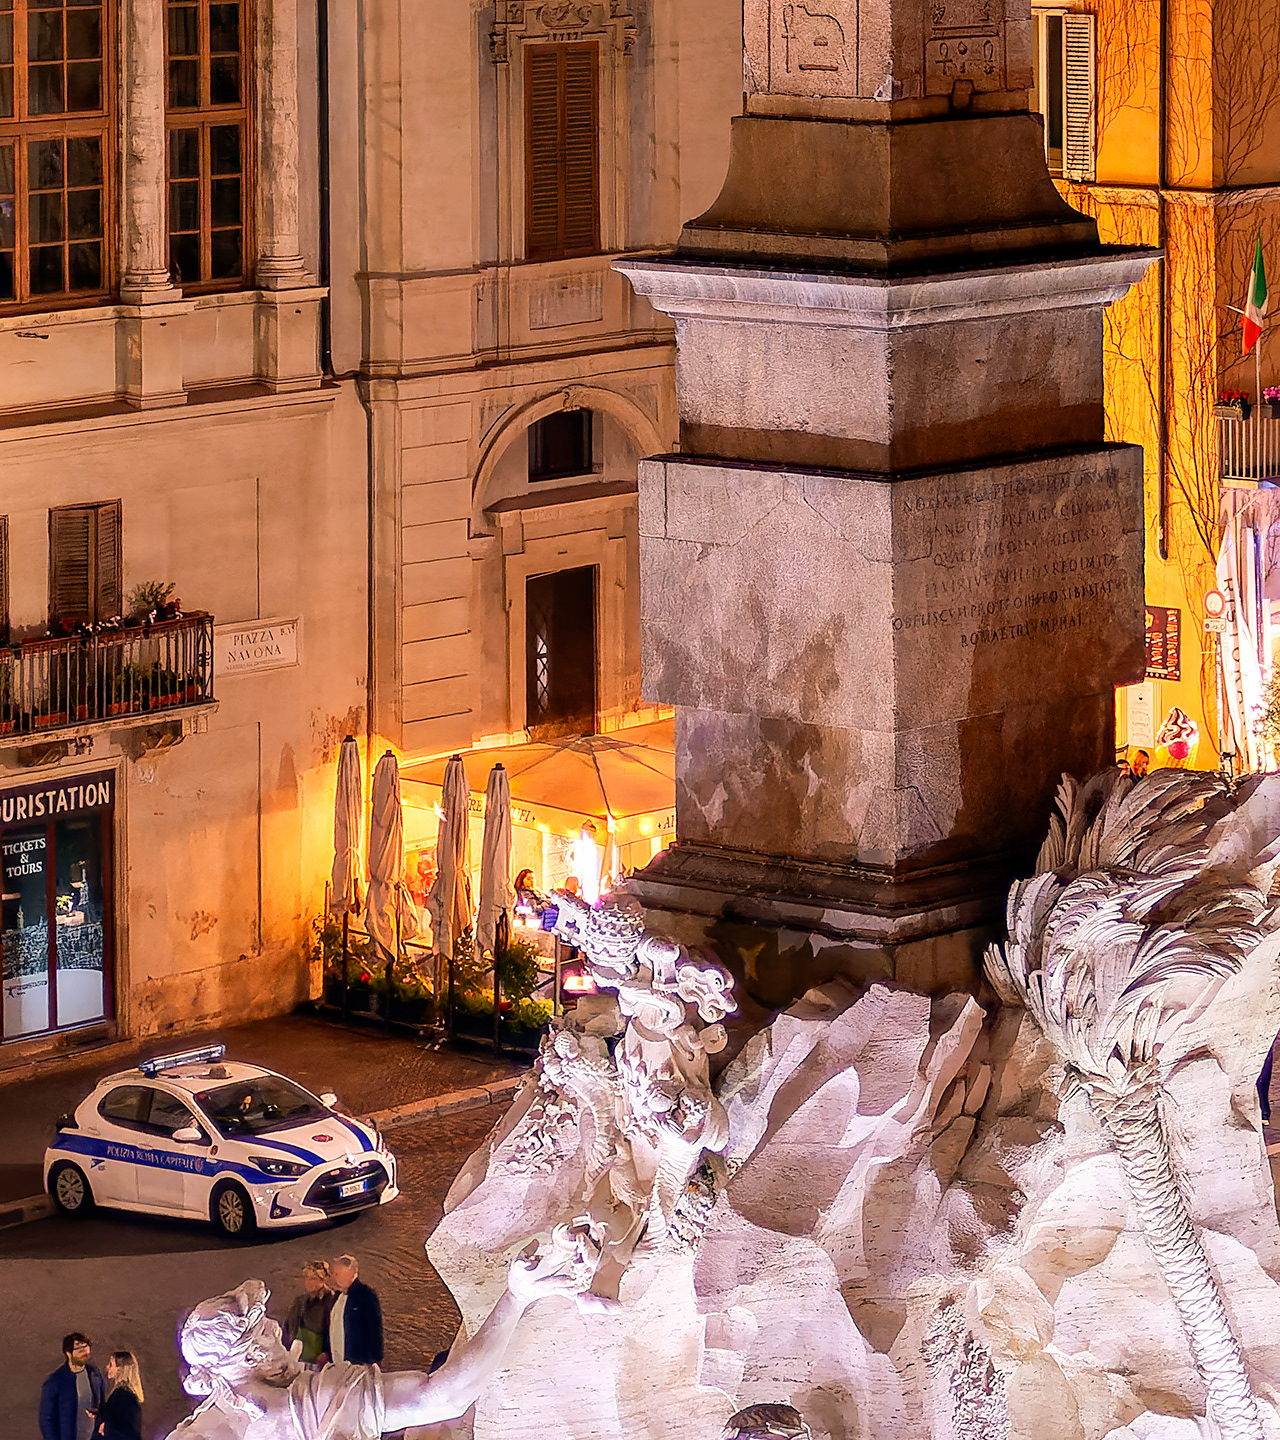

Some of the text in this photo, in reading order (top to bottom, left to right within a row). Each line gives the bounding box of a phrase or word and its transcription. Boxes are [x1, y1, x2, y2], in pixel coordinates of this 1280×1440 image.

[233, 629, 274, 646] PIAZZA
[228, 644, 281, 663] NAVONA
[0, 781, 110, 823] URISTATION
[2, 837, 46, 856] TICKETS
[20, 853, 29, 864] &
[6, 861, 43, 878] TOURS
